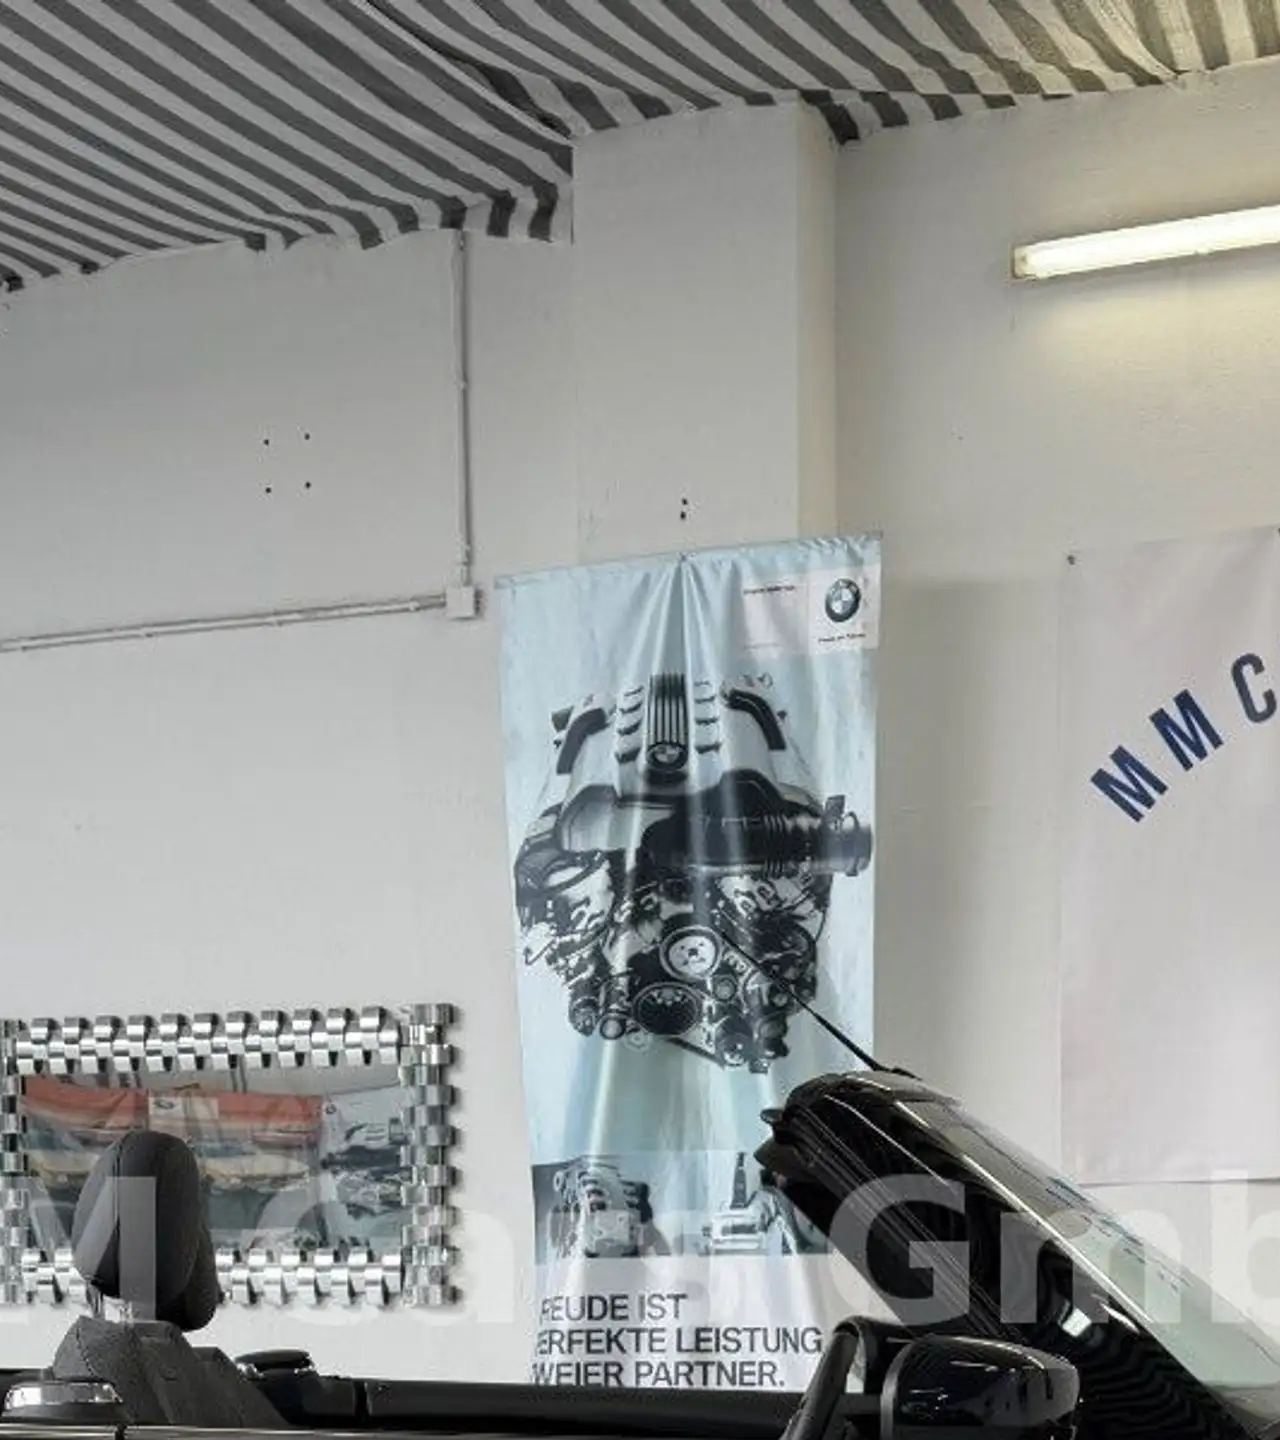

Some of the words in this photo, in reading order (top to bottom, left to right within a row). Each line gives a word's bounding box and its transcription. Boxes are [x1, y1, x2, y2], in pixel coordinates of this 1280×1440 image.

[1090, 745, 1169, 823] M
[1149, 688, 1224, 772] M
[637, 1293, 688, 1322] IST
[675, 1326, 823, 1354] LEISTUNG
[634, 1360, 785, 1388] PARTNER.
